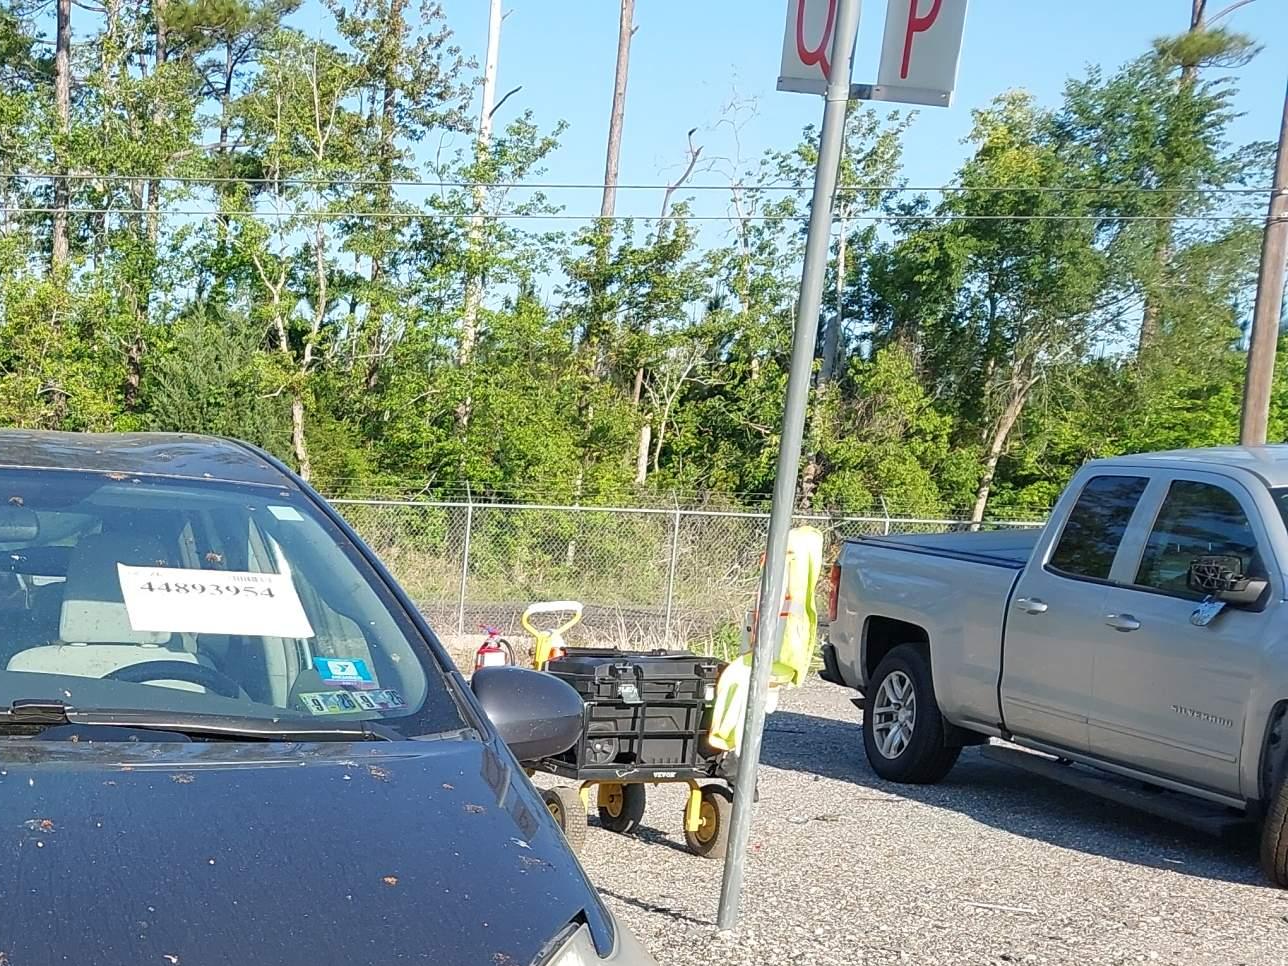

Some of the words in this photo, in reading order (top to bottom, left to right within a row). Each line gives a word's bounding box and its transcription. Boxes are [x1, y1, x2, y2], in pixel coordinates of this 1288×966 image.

[139, 580, 275, 598] 44893954
[312, 698, 324, 711] 9
[360, 696, 374, 708] 9
